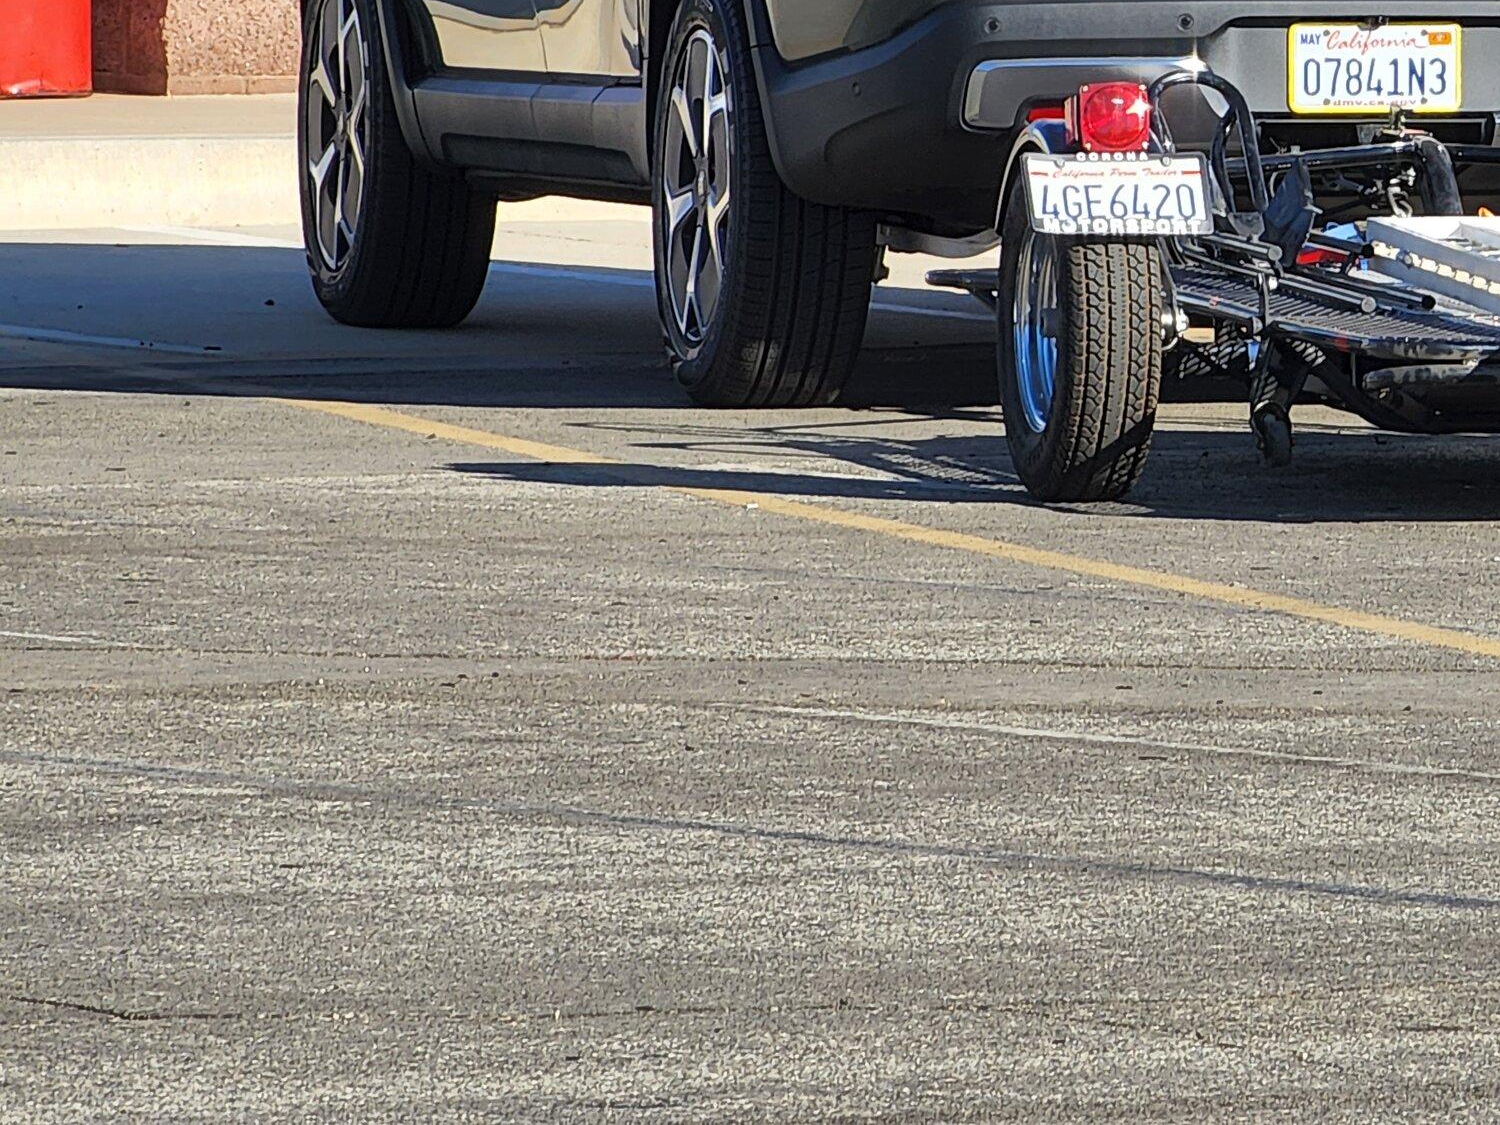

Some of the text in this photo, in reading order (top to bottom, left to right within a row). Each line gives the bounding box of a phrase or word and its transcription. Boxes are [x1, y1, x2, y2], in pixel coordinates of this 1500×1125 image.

[1300, 33, 1321, 45] MAY
[1327, 30, 1428, 55] California
[1303, 58, 1446, 96] 07841N3
[1076, 151, 1149, 162] CORONA
[1041, 183, 1196, 219] 4GE6420
[1042, 218, 1201, 235] MOTORSPORT
